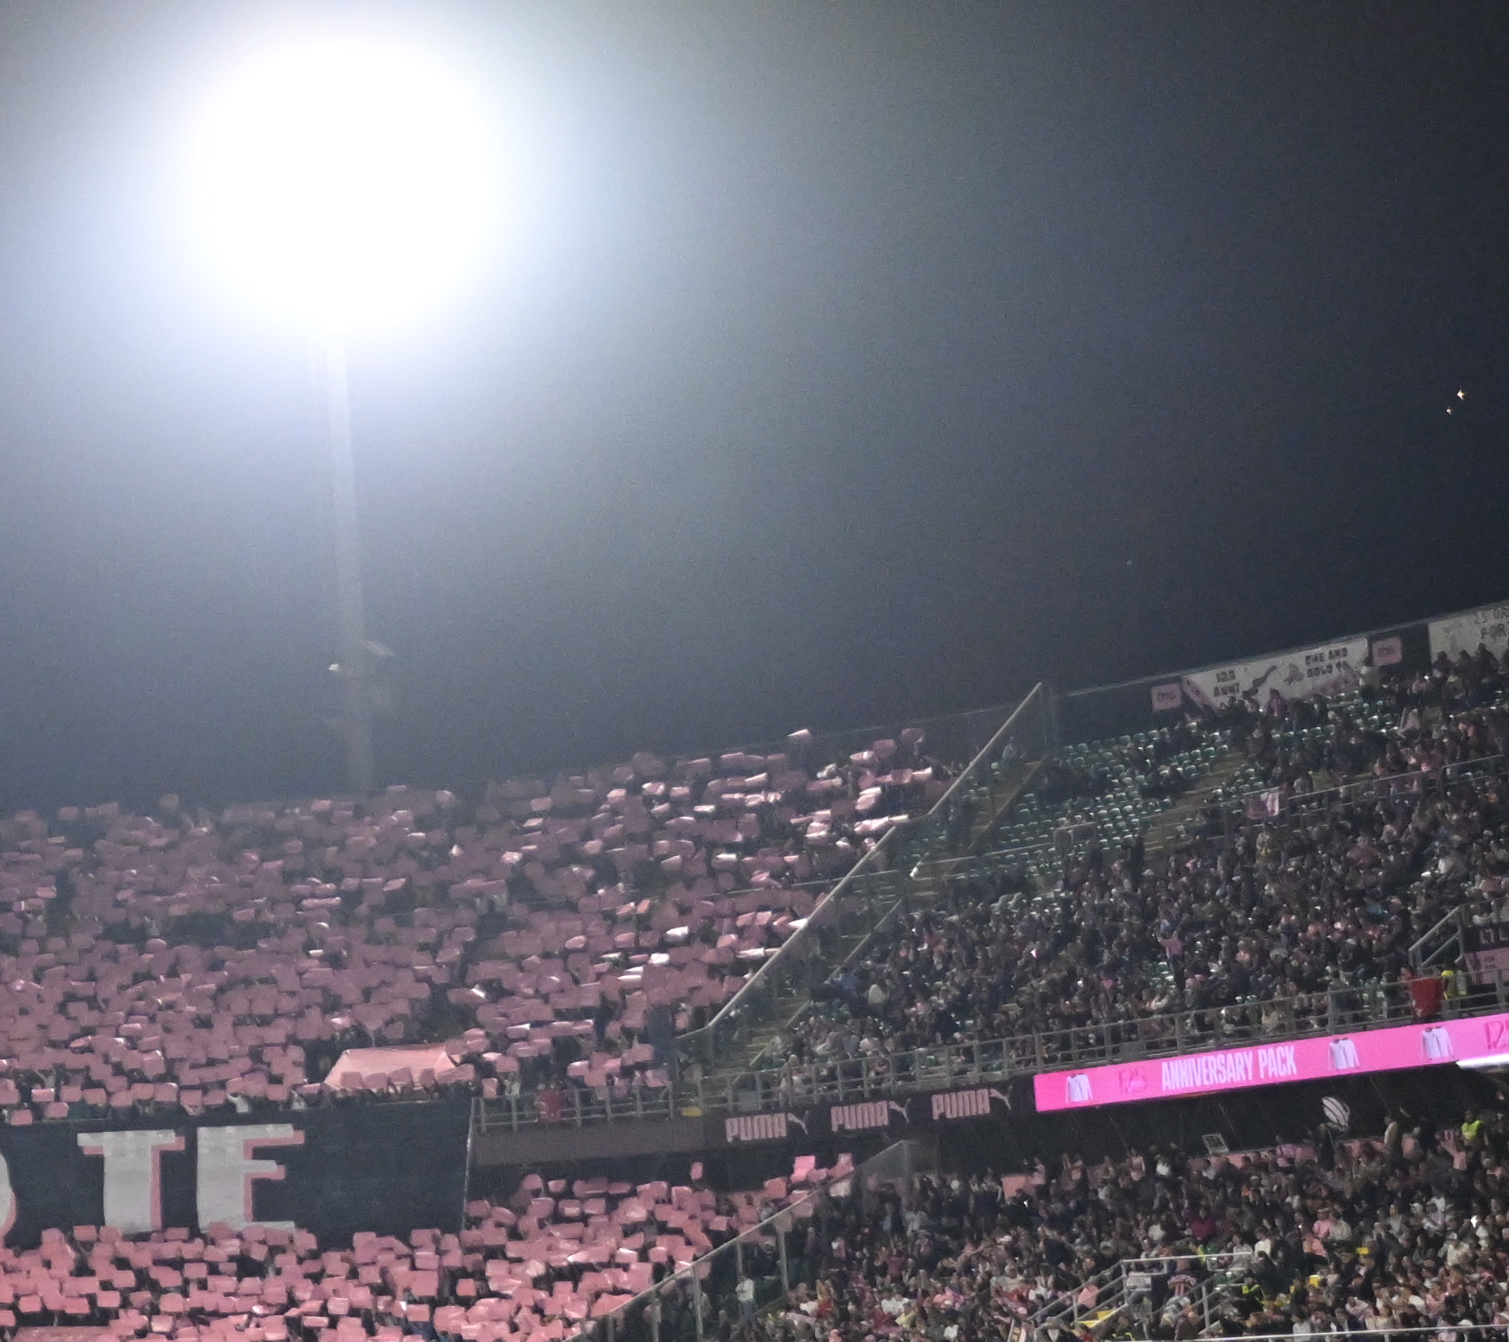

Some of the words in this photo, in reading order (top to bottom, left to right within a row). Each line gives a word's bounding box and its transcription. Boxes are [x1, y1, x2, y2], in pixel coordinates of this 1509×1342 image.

[1161, 1050, 1253, 1092] ANNIVERSARY
[1258, 1045, 1298, 1080] PACK
[830, 1100, 889, 1132] PUMA
[932, 1088, 991, 1120] PUMA
[725, 1112, 787, 1142] PUMA
[77, 1124, 305, 1234] TE
